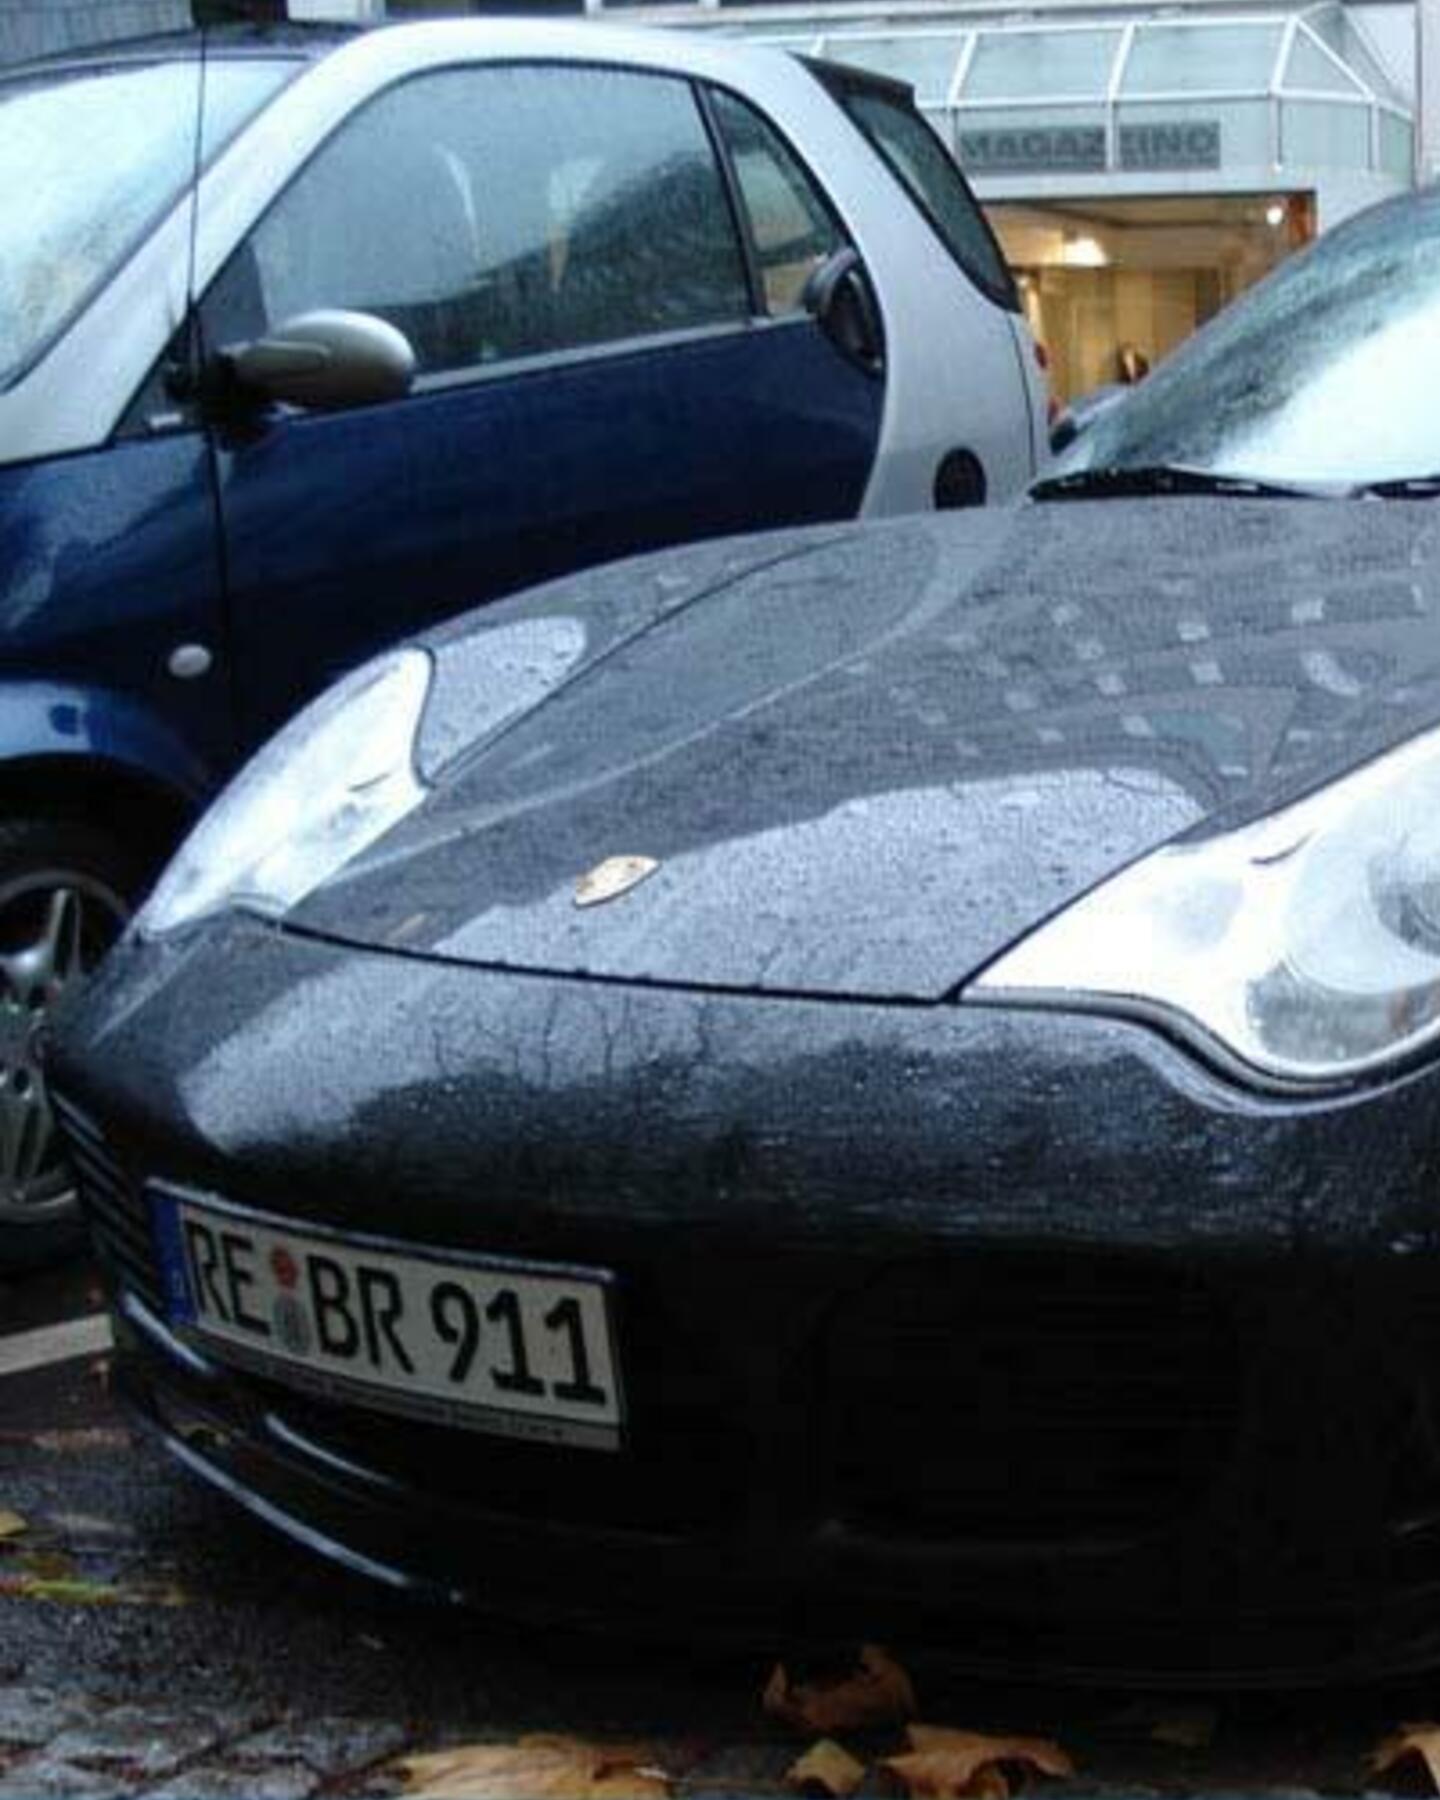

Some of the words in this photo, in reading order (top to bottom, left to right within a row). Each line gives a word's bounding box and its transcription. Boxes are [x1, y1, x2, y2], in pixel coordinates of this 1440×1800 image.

[187, 1222, 270, 1336] RE
[307, 1254, 414, 1374] BR
[431, 1281, 606, 1406] 911
